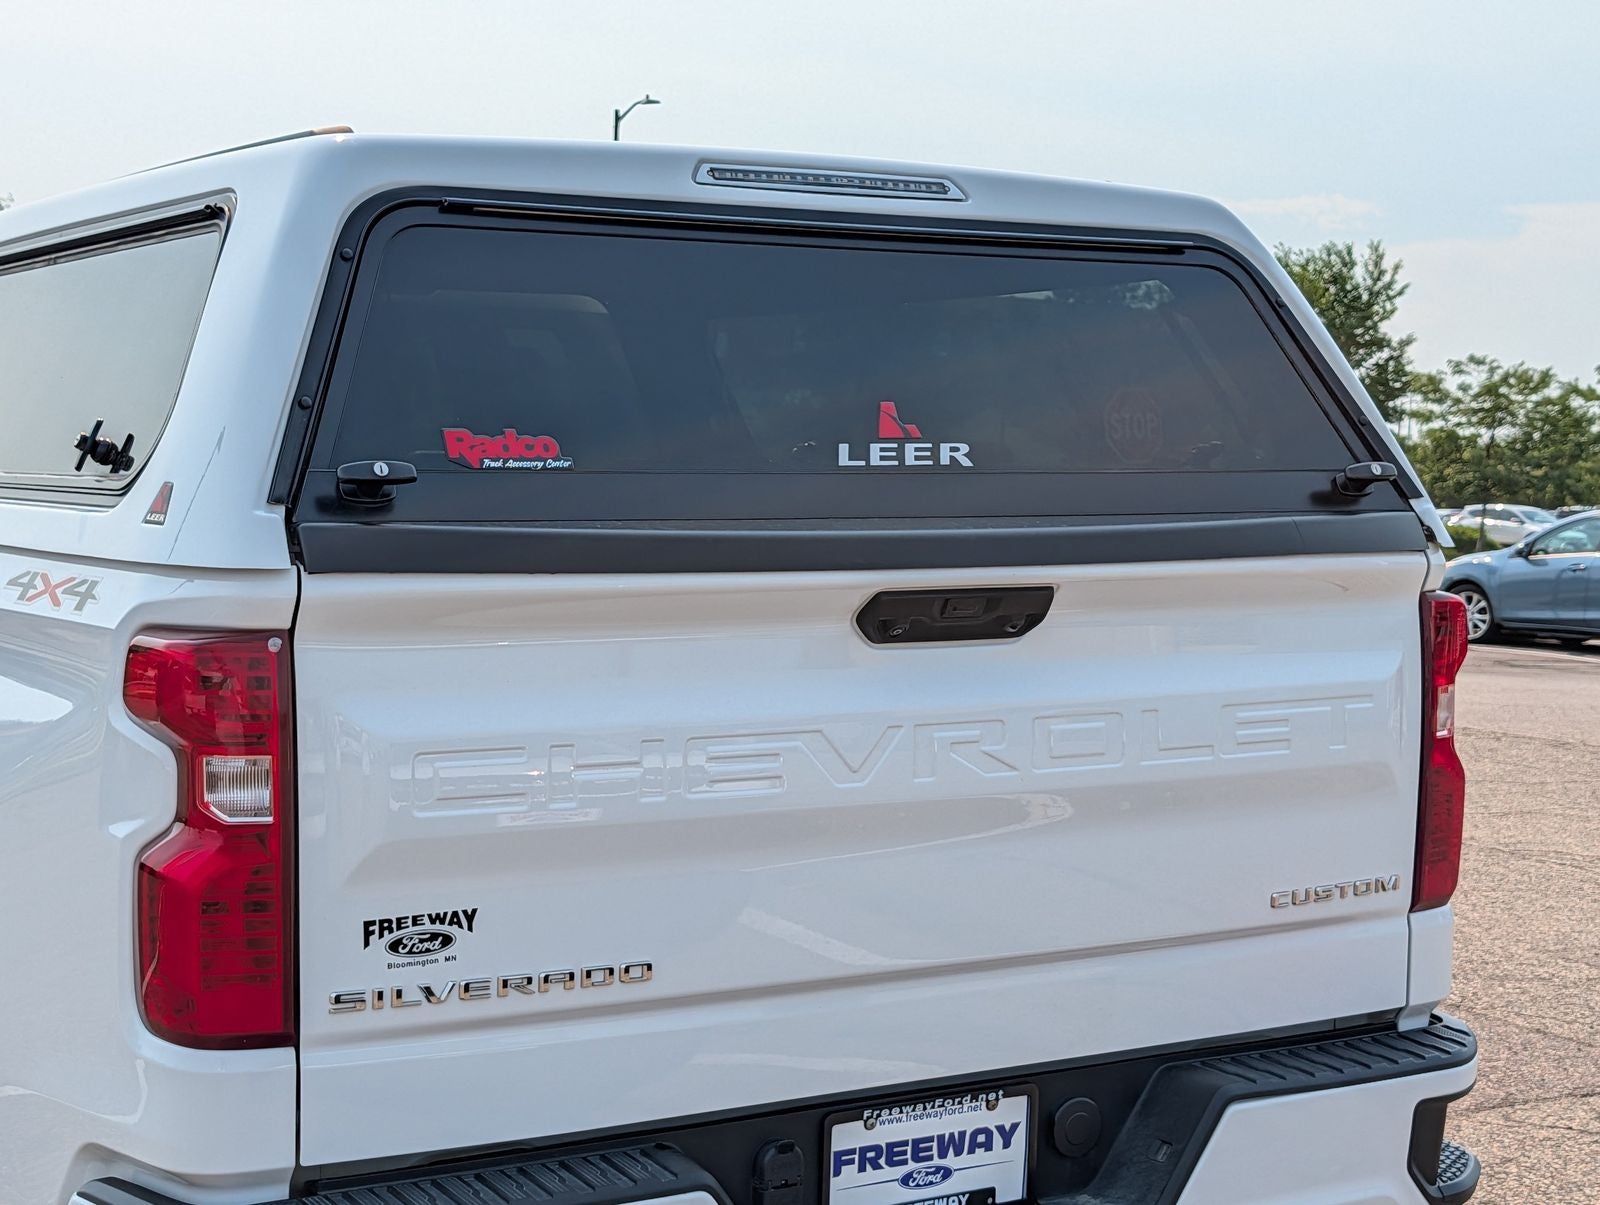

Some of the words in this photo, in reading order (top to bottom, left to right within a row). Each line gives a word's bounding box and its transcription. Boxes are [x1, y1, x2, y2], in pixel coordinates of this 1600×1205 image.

[1110, 411, 1159, 439] STOP
[442, 428, 560, 469] Radco
[838, 442, 974, 467] LEER
[483, 458, 504, 469] Truck
[505, 458, 544, 470] Accessory
[545, 458, 572, 469] Center
[146, 512, 166, 522] LEER
[411, 693, 1374, 818] CHEVROLET
[1270, 874, 1401, 909] CUSTOM
[362, 907, 479, 951] FREEWAY
[398, 934, 443, 956] Ford
[387, 957, 439, 970] Bloomington
[444, 954, 458, 962] MN
[328, 960, 653, 1015] SILVERADO
[863, 1089, 1005, 1121] FreewayFord.net
[878, 1102, 984, 1127] www.freewayford.net
[832, 1120, 1022, 1178] FREEWAY
[908, 1167, 943, 1187] Ford
